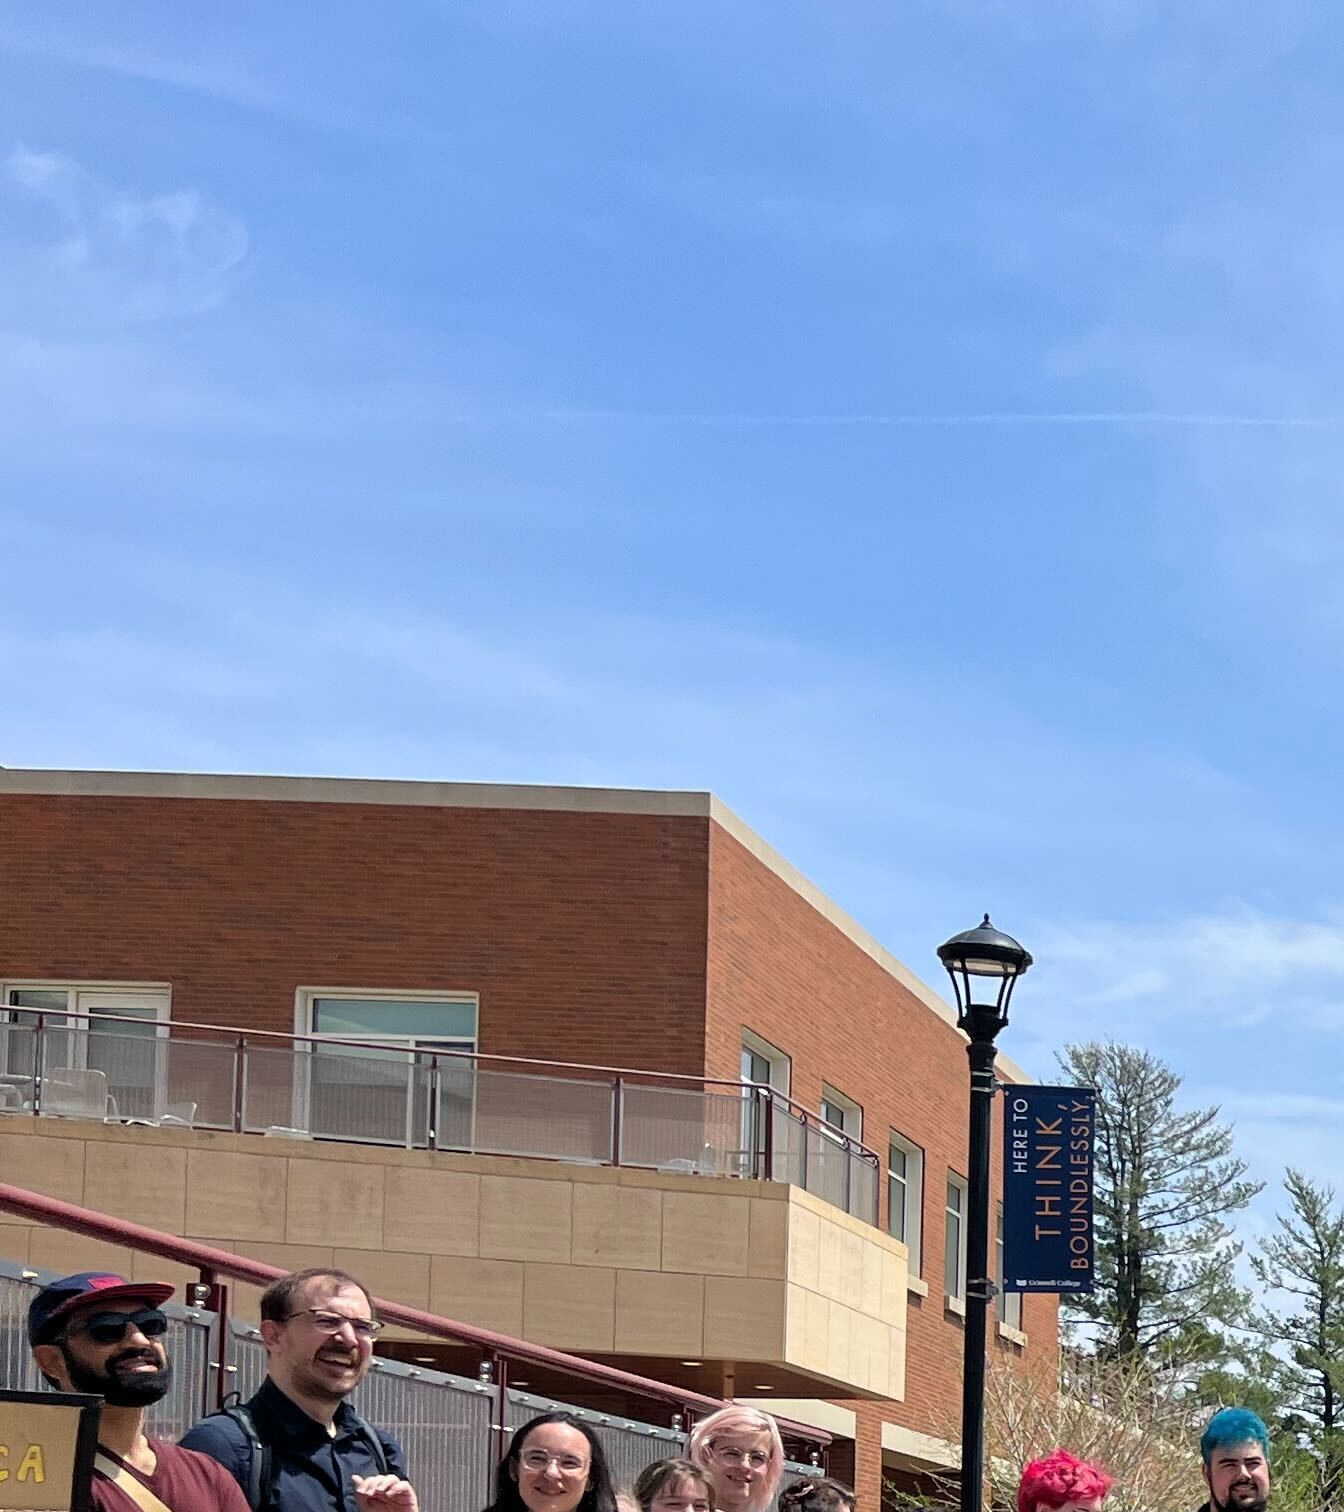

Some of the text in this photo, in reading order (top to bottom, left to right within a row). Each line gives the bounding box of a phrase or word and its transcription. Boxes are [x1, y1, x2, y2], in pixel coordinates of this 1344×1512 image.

[1013, 1098, 1029, 1173] HERE TO
[1035, 1103, 1068, 1241] THINK,
